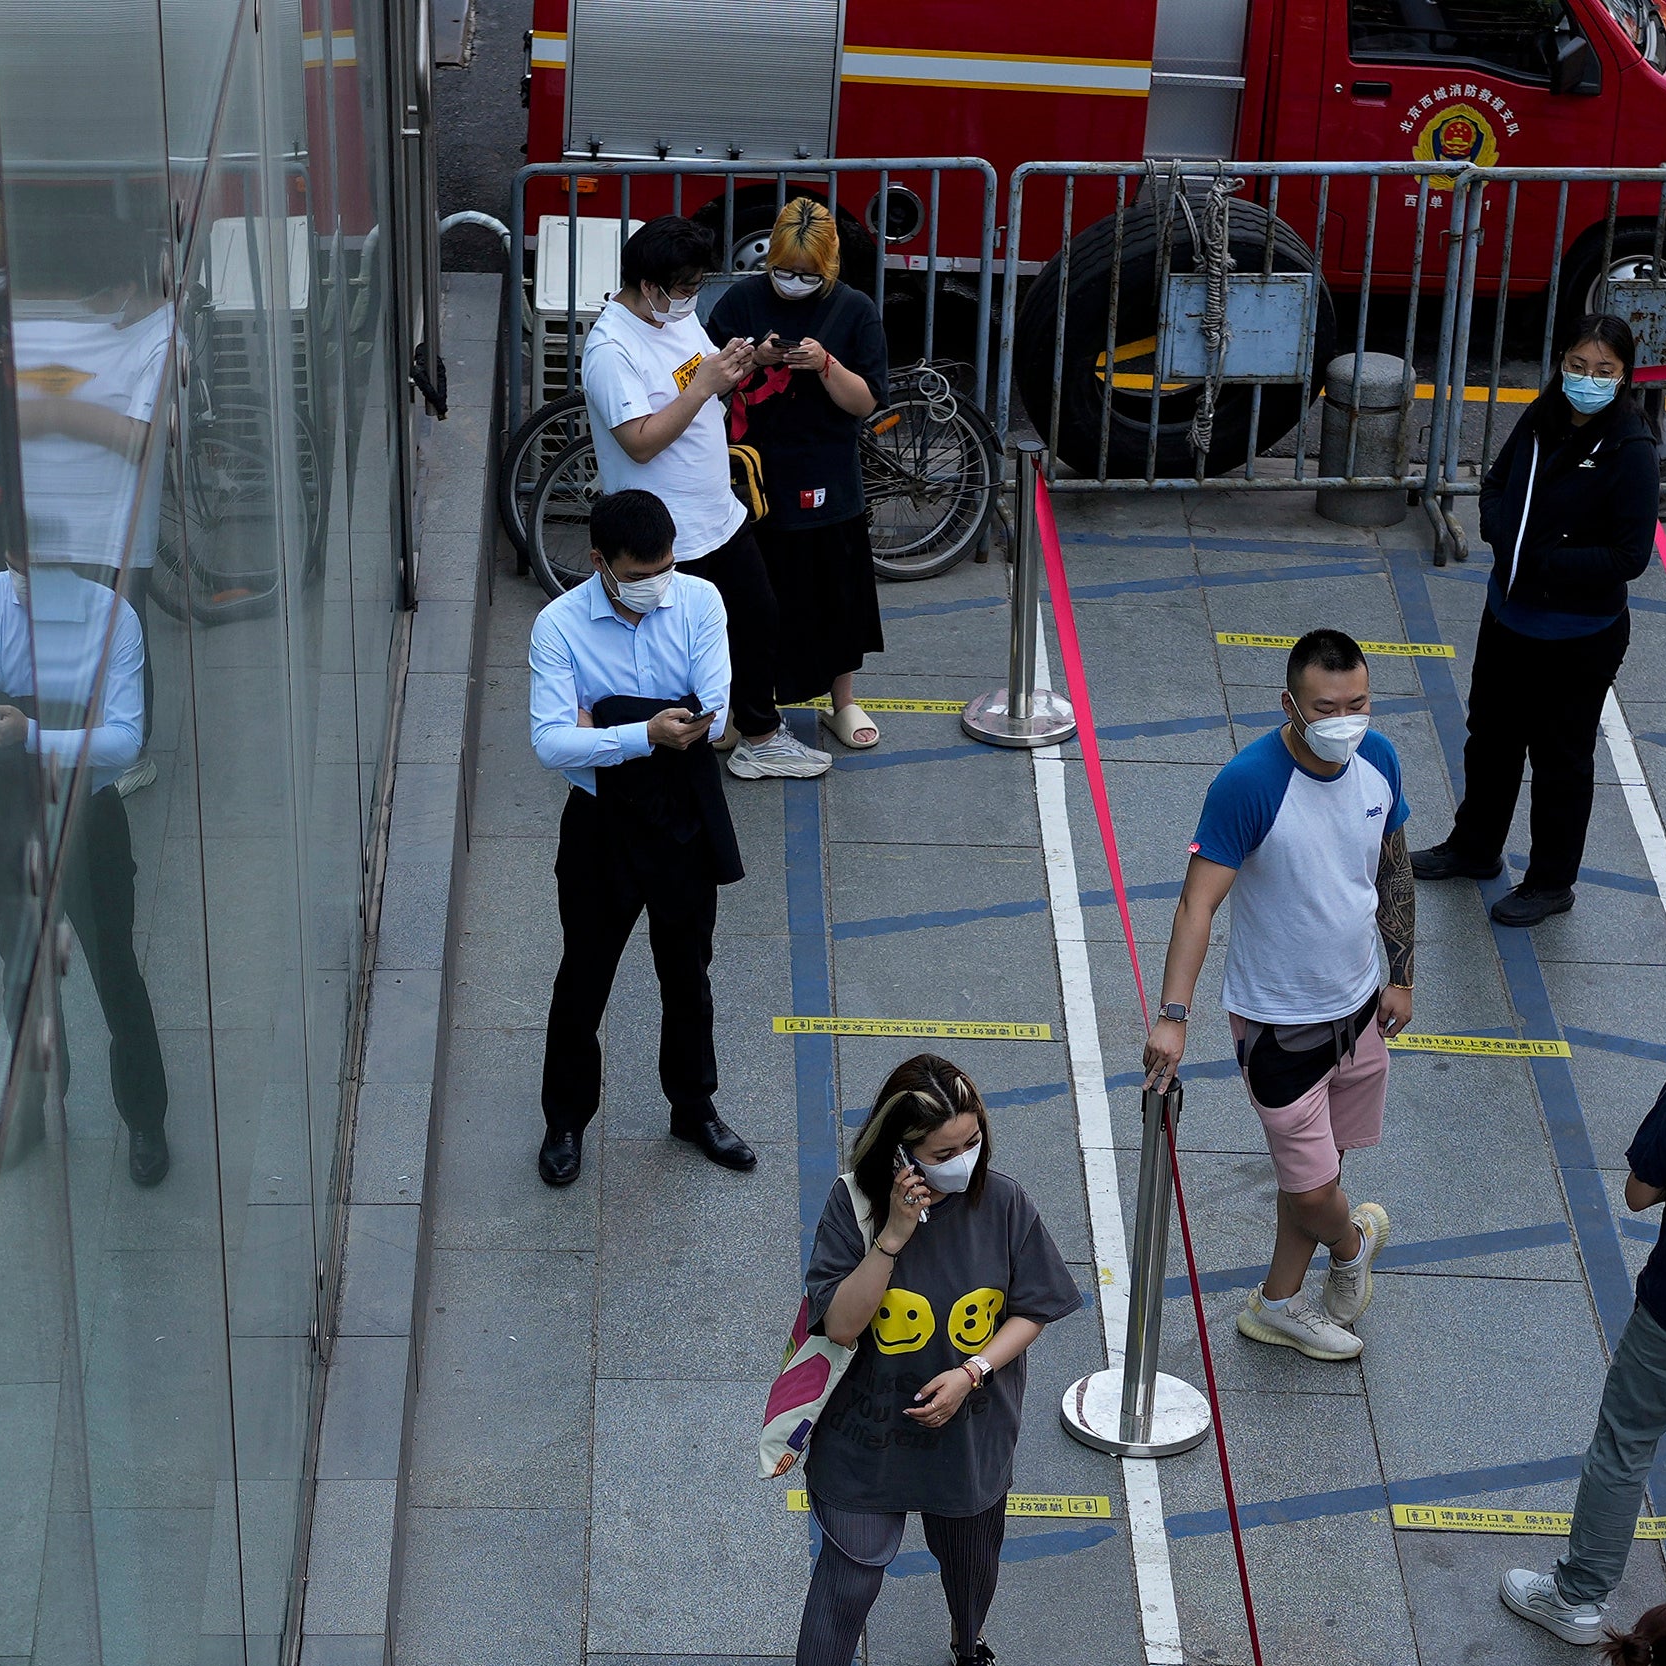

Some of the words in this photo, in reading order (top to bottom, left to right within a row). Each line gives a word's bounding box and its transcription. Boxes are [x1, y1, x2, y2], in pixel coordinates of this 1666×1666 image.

[1399, 83, 1521, 137] 北京西城消防救援支队
[1440, 1510, 1515, 1523] 请戴好口罩
